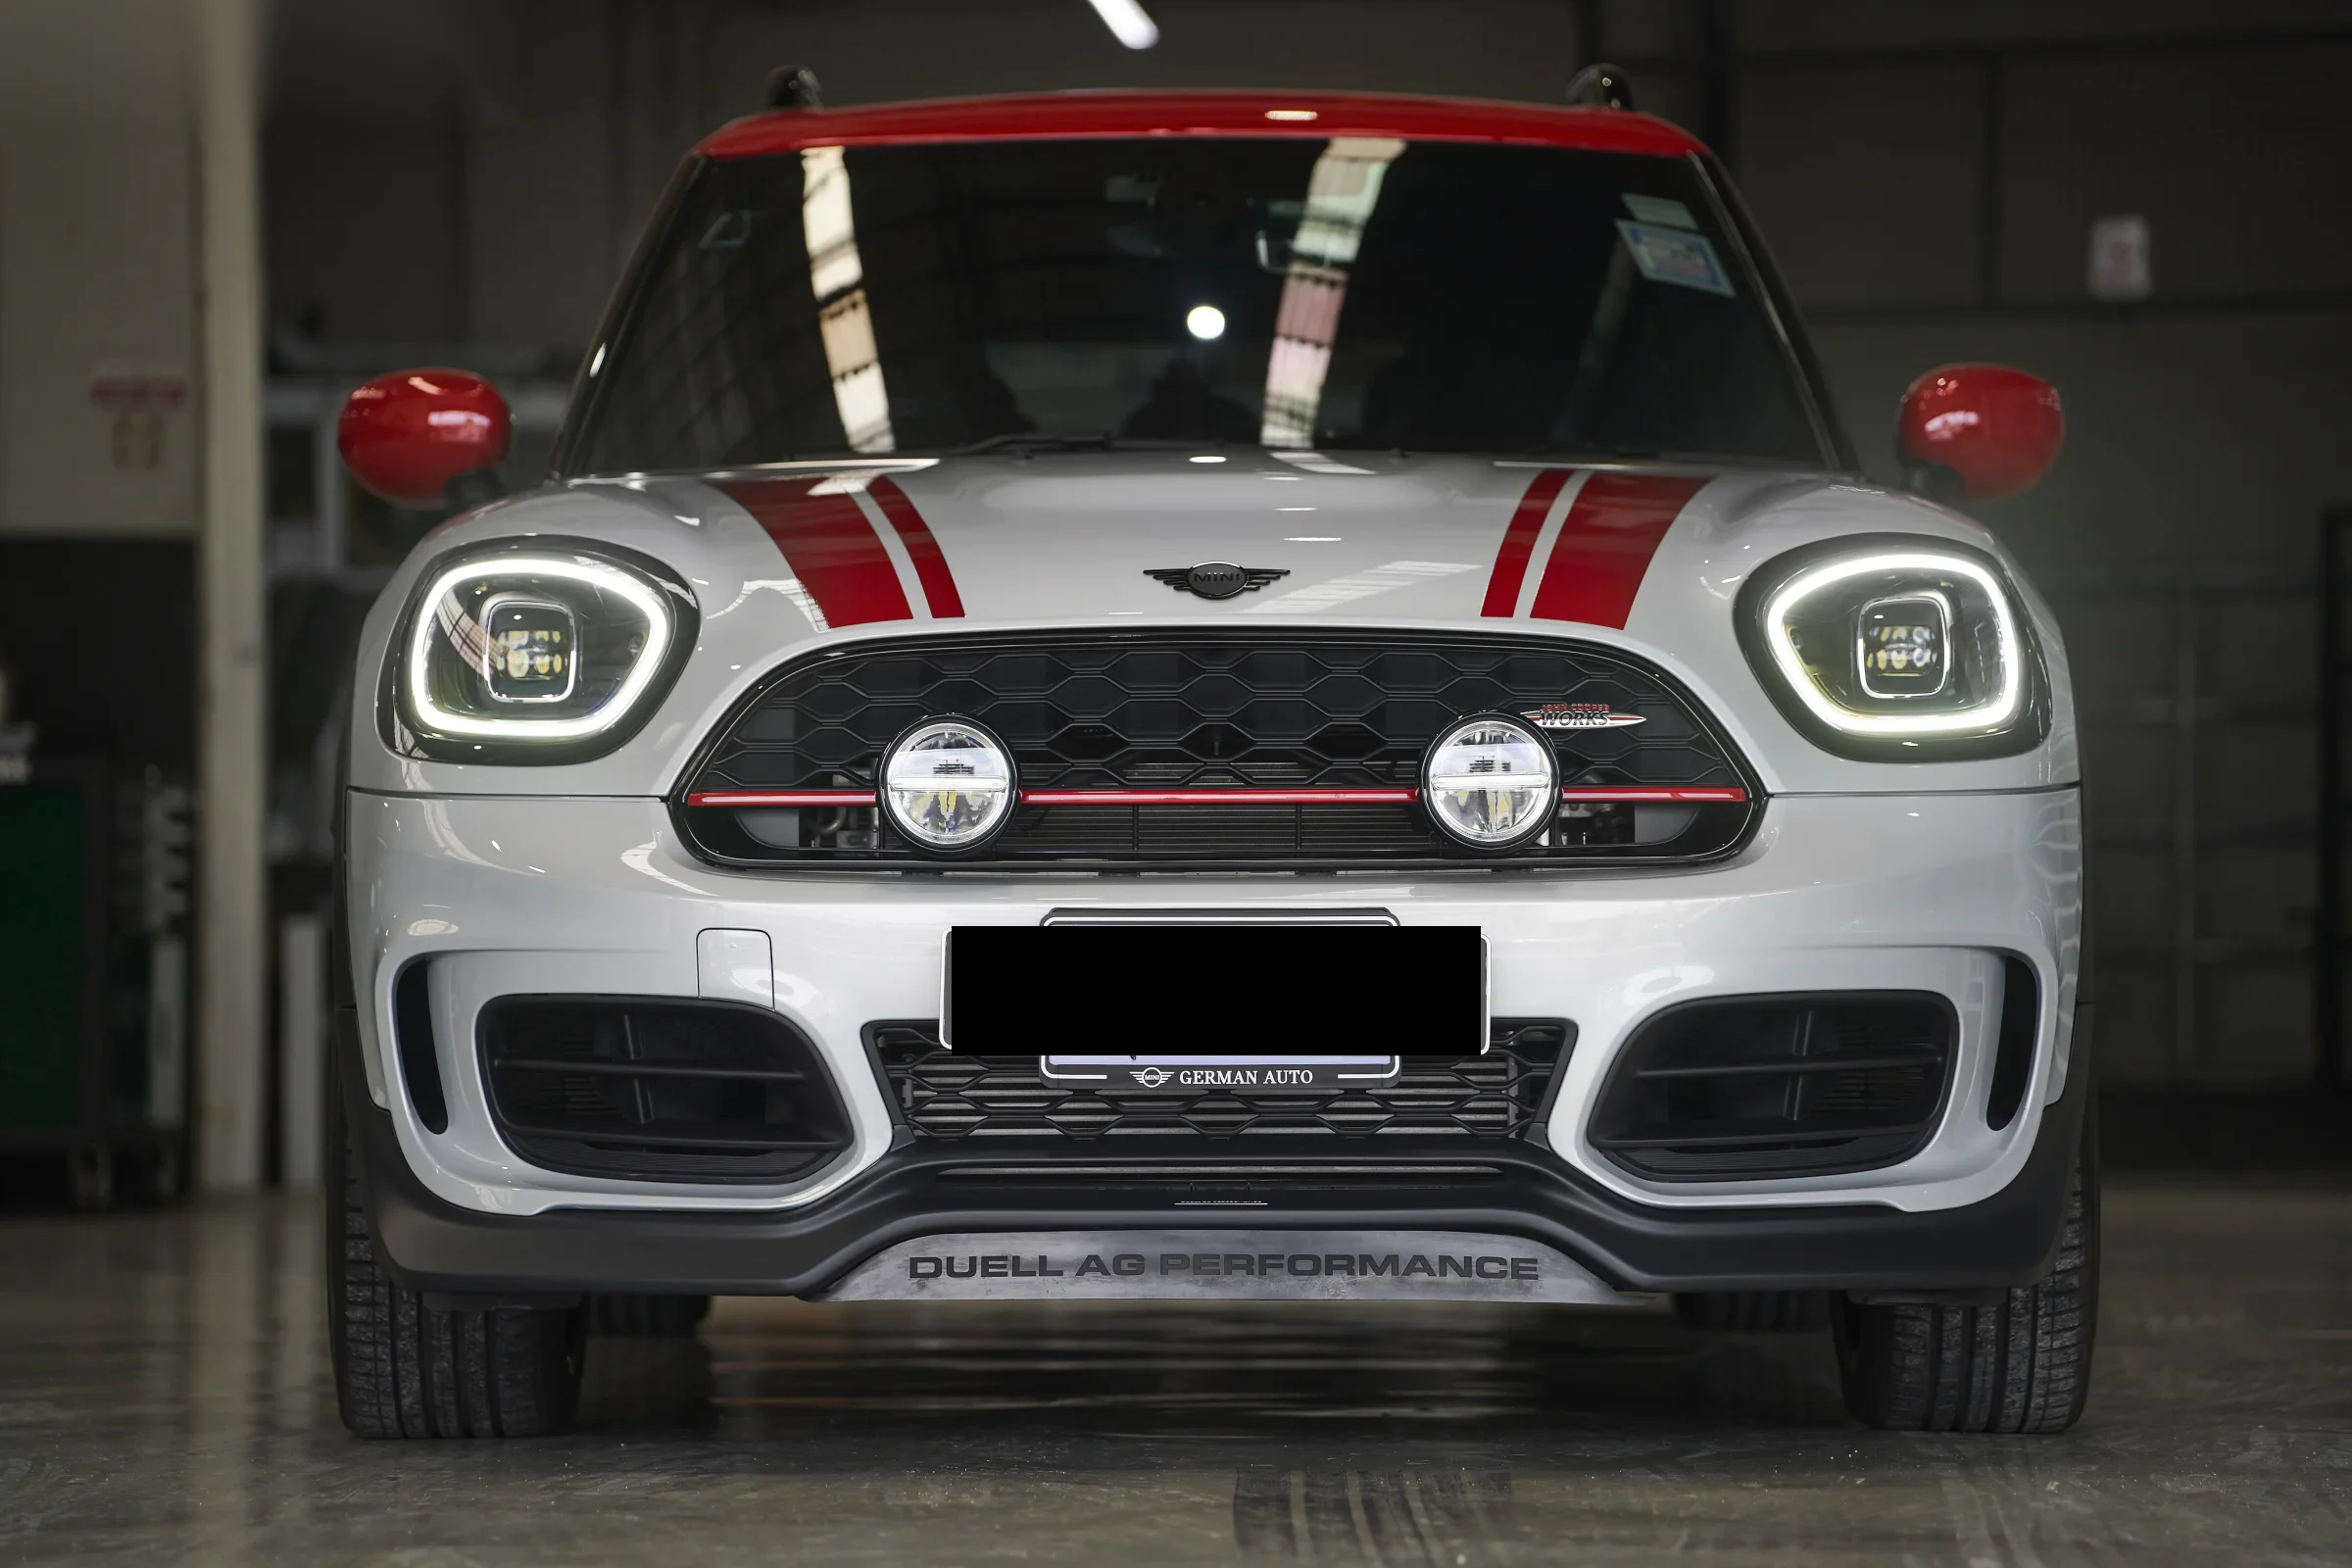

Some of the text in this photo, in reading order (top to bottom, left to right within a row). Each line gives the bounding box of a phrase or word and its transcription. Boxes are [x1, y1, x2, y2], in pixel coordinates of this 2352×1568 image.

[1194, 572, 1240, 582] MINI
[1540, 703, 1610, 711] JOHN COOPER
[1540, 710, 1609, 726] WORKS
[1179, 1070, 1313, 1085] GERMAN AUTO
[909, 1253, 1539, 1280] DUELL AG PERFORMANCE
